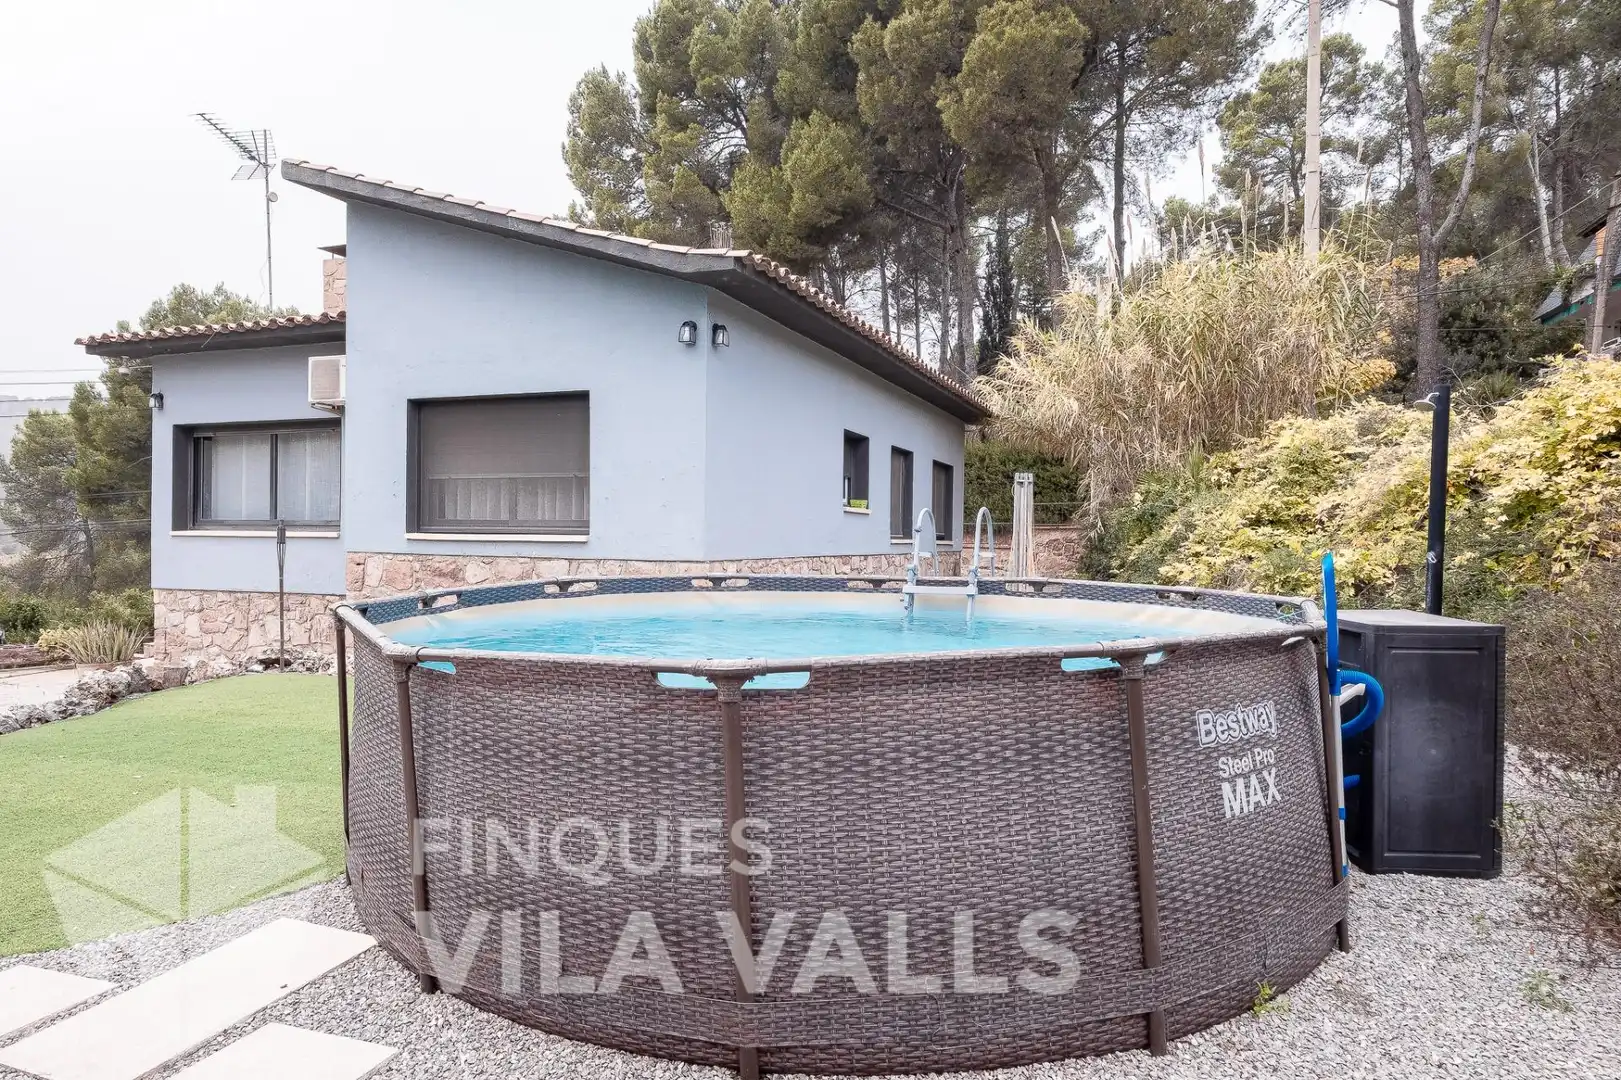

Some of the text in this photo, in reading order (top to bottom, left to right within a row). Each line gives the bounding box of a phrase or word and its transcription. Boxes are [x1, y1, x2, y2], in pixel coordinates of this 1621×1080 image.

[1196, 700, 1277, 747] Bestway
[1219, 747, 1275, 778] Steel Pro
[1221, 767, 1281, 818] MAX
